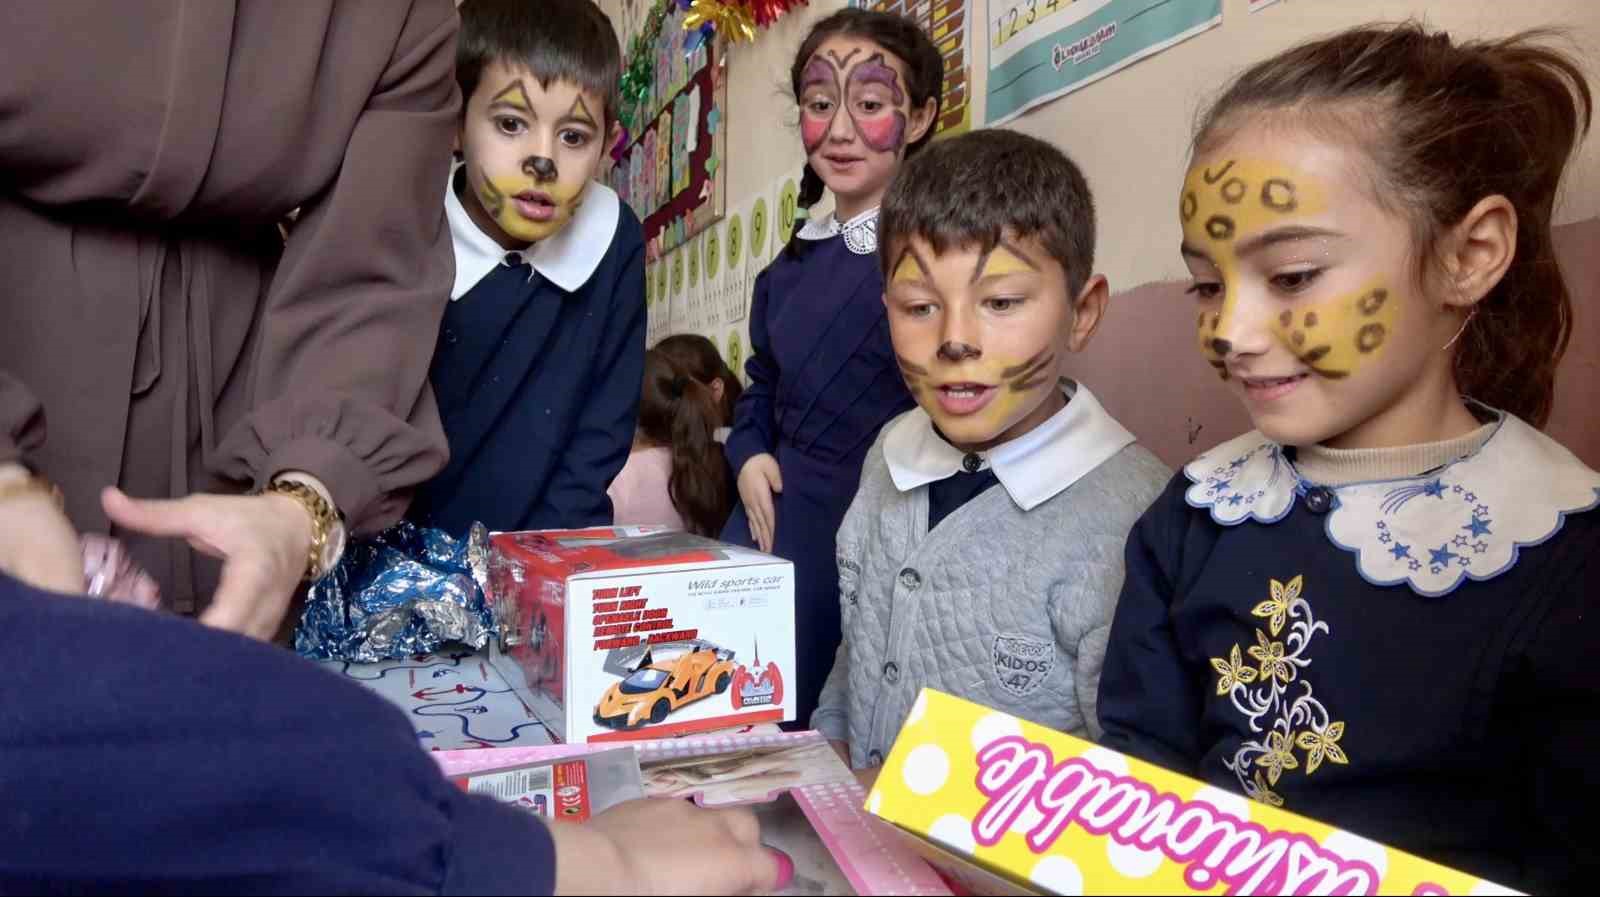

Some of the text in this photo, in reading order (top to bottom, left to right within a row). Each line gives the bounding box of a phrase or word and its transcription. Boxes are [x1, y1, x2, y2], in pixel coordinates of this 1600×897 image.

[1009, 7, 1018, 37] 2
[1026, 0, 1036, 24] 3
[754, 211, 762, 243] 9
[782, 194, 794, 229] 10
[688, 575, 784, 590] Wild sports car
[633, 618, 674, 632] CONTROL
[997, 654, 1048, 673] KIDOS
[1007, 673, 1031, 690] 47
[972, 736, 1452, 895] ashionable
